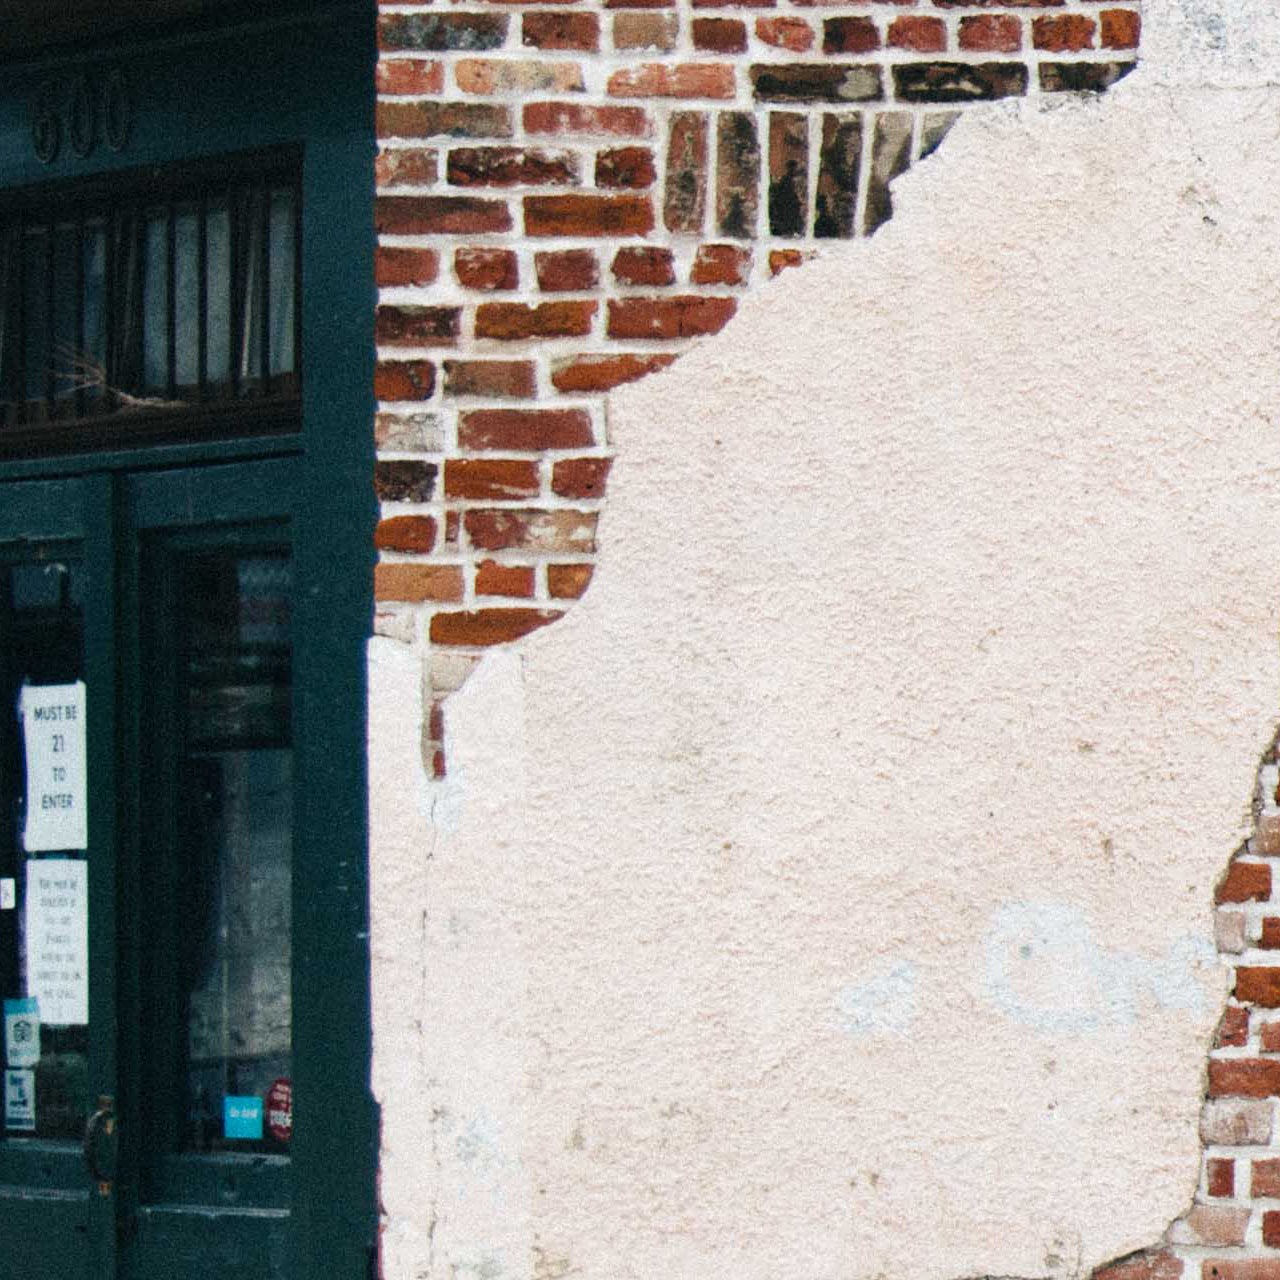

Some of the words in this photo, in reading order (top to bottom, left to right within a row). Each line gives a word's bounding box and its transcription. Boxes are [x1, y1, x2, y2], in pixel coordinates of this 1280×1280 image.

[34, 705, 62, 720] MUST
[65, 705, 77, 719] BE
[52, 735, 65, 752] 21
[52, 767, 66, 781] TO
[42, 794, 74, 809] ENTER
